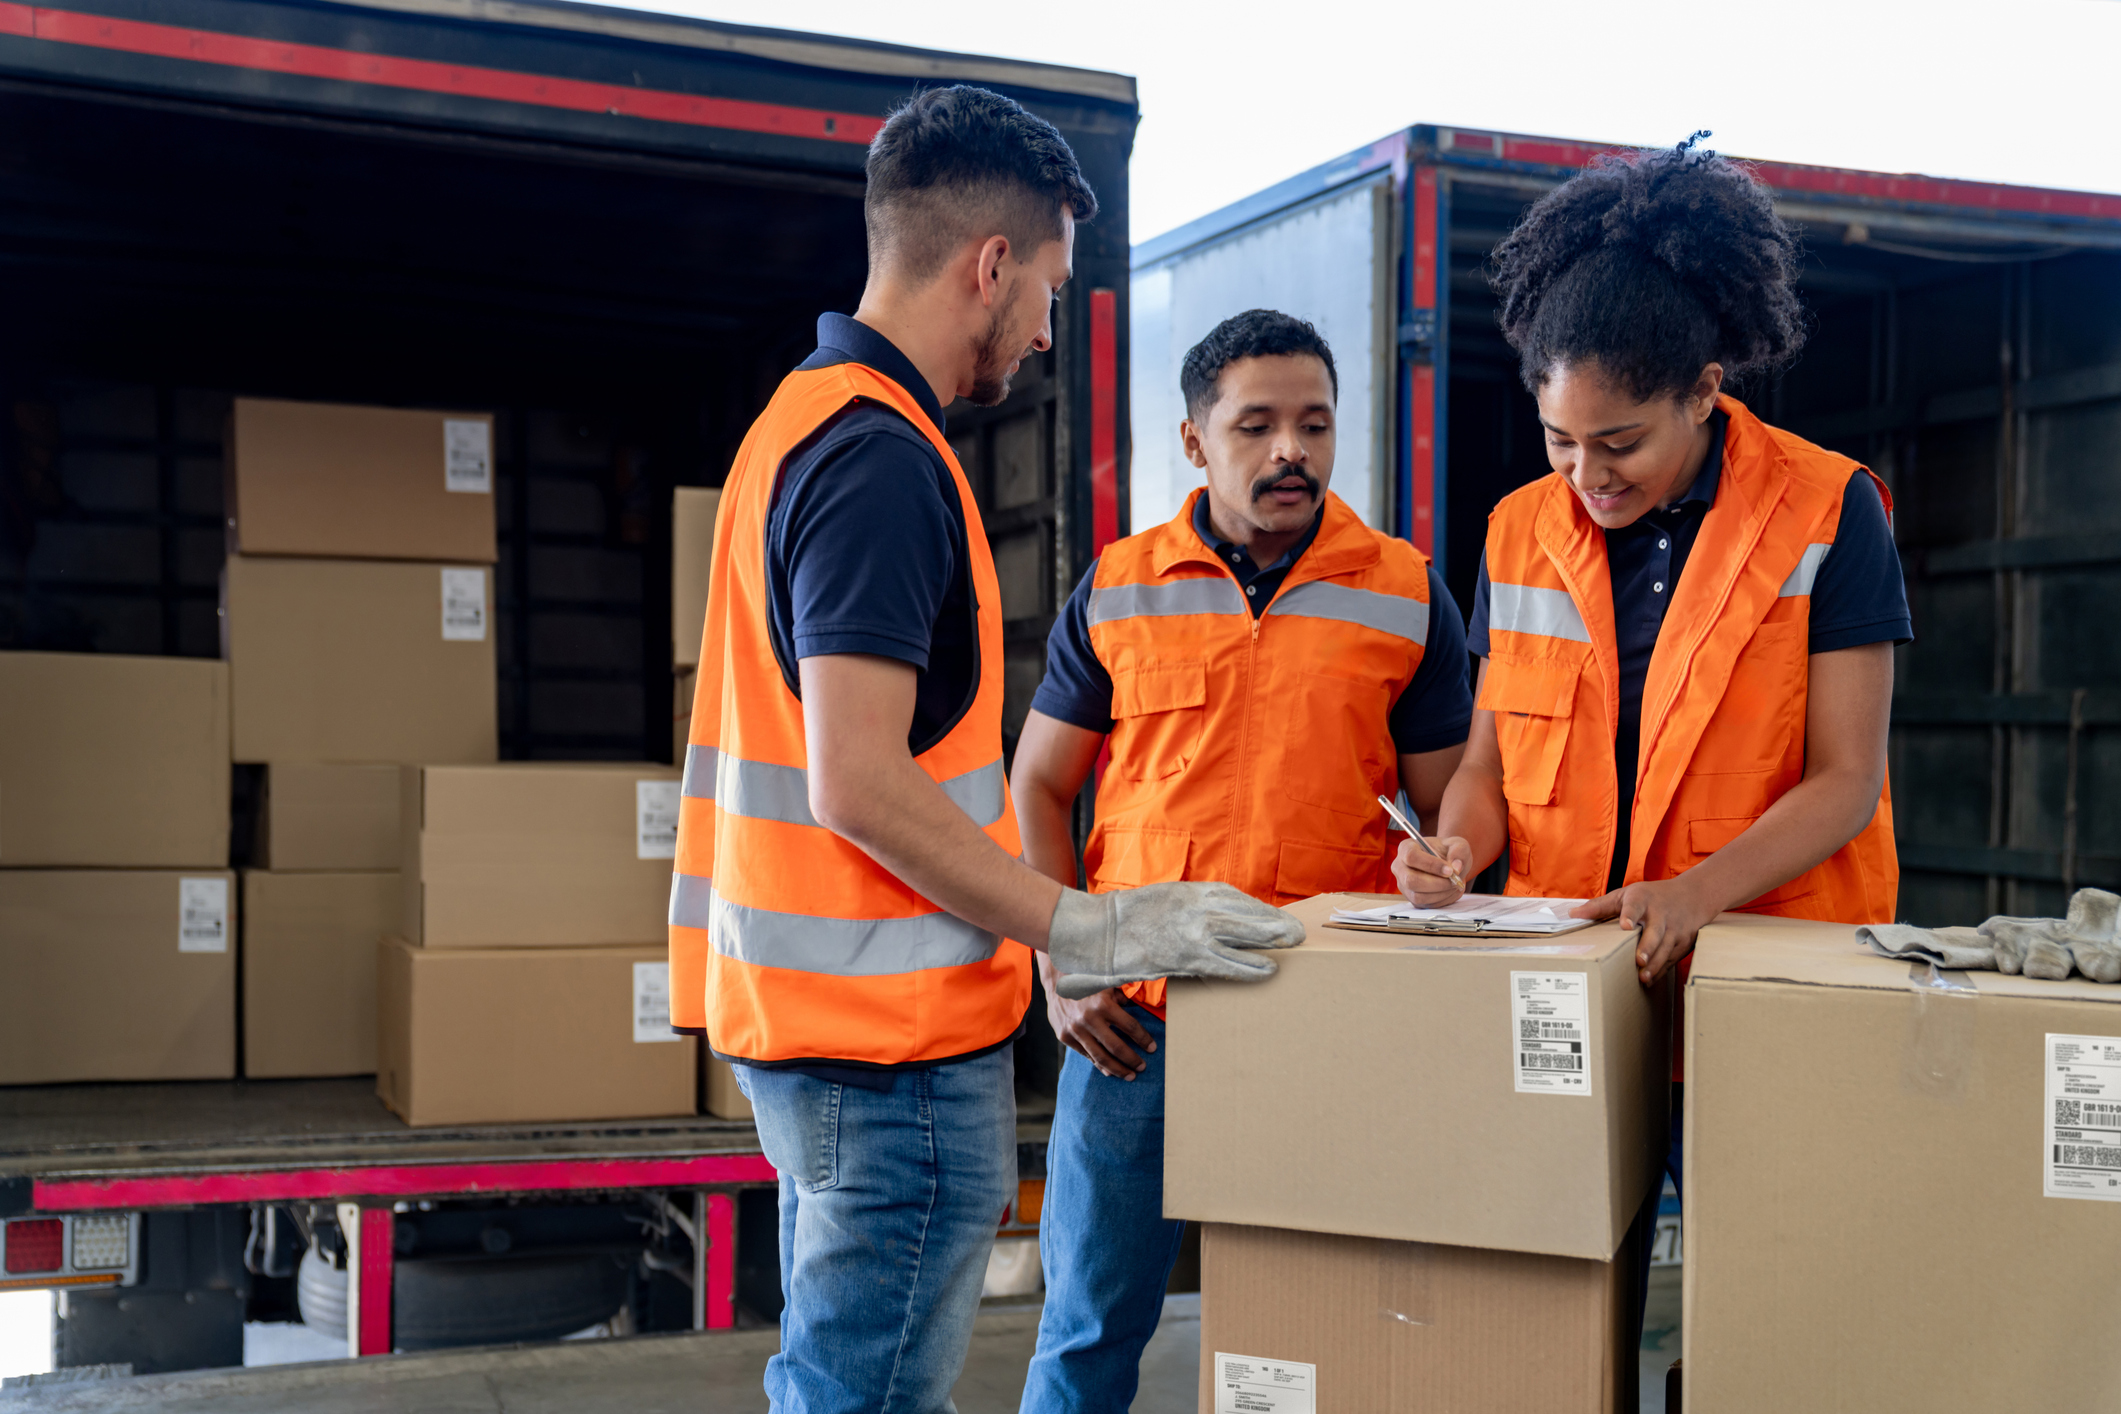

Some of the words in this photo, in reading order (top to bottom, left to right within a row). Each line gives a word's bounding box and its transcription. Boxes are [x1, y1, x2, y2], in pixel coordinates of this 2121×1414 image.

[2084, 1103, 2096, 1111] GBR
[2109, 1105, 2121, 1113] 9-0
[1651, 1226, 1682, 1261] 27
